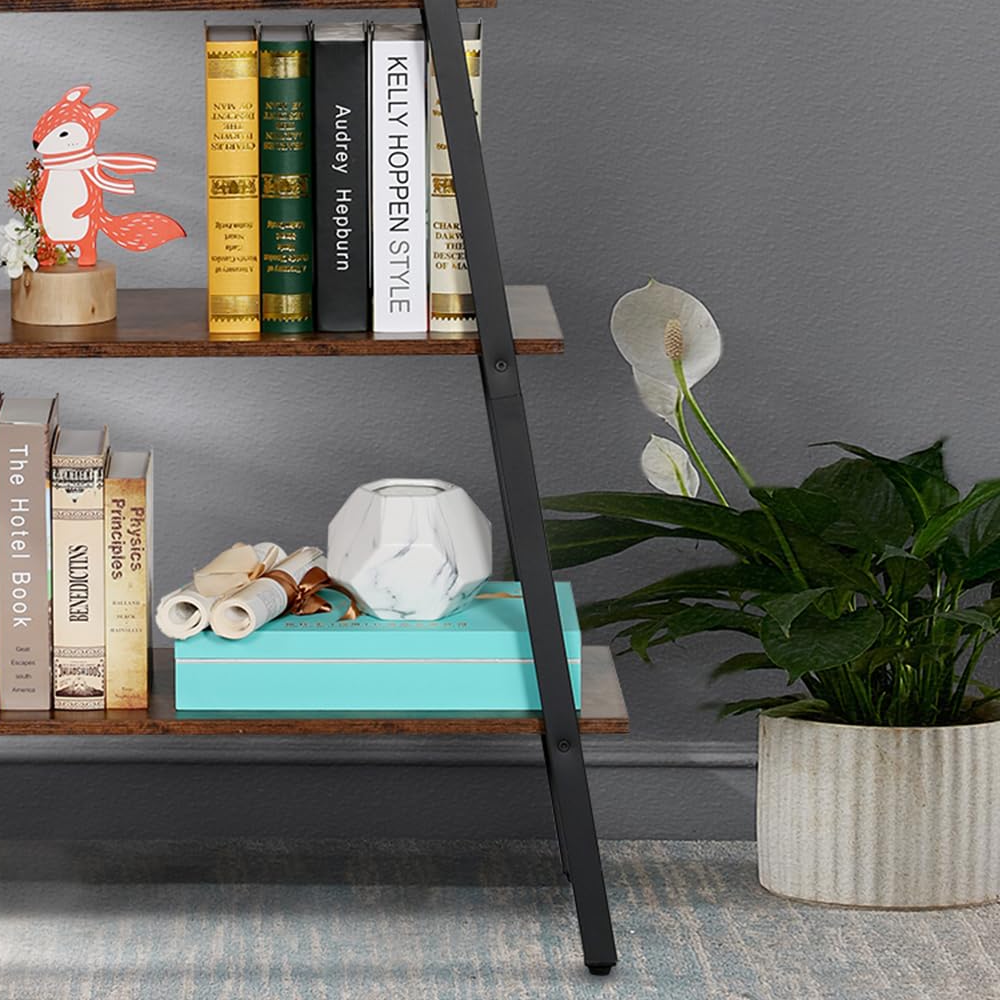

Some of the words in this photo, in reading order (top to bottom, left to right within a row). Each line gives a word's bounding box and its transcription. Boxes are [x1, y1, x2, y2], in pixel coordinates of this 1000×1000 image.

[387, 56, 408, 127] KELLY
[331, 104, 351, 174] Audrey
[388, 135, 409, 231] HOPPEN
[332, 189, 352, 271] Hepburn
[433, 222, 460, 230] CHAR
[433, 251, 465, 260] DESCE
[435, 231, 464, 240] DARW
[389, 240, 410, 313] STYLE
[452, 262, 469, 270] MA
[9, 445, 28, 485] The
[10, 499, 30, 558] Hotel
[108, 498, 126, 580] Principles
[127, 507, 146, 572] Physics
[12, 572, 32, 627] Book
[68, 545, 89, 622] BENEDICTINS
